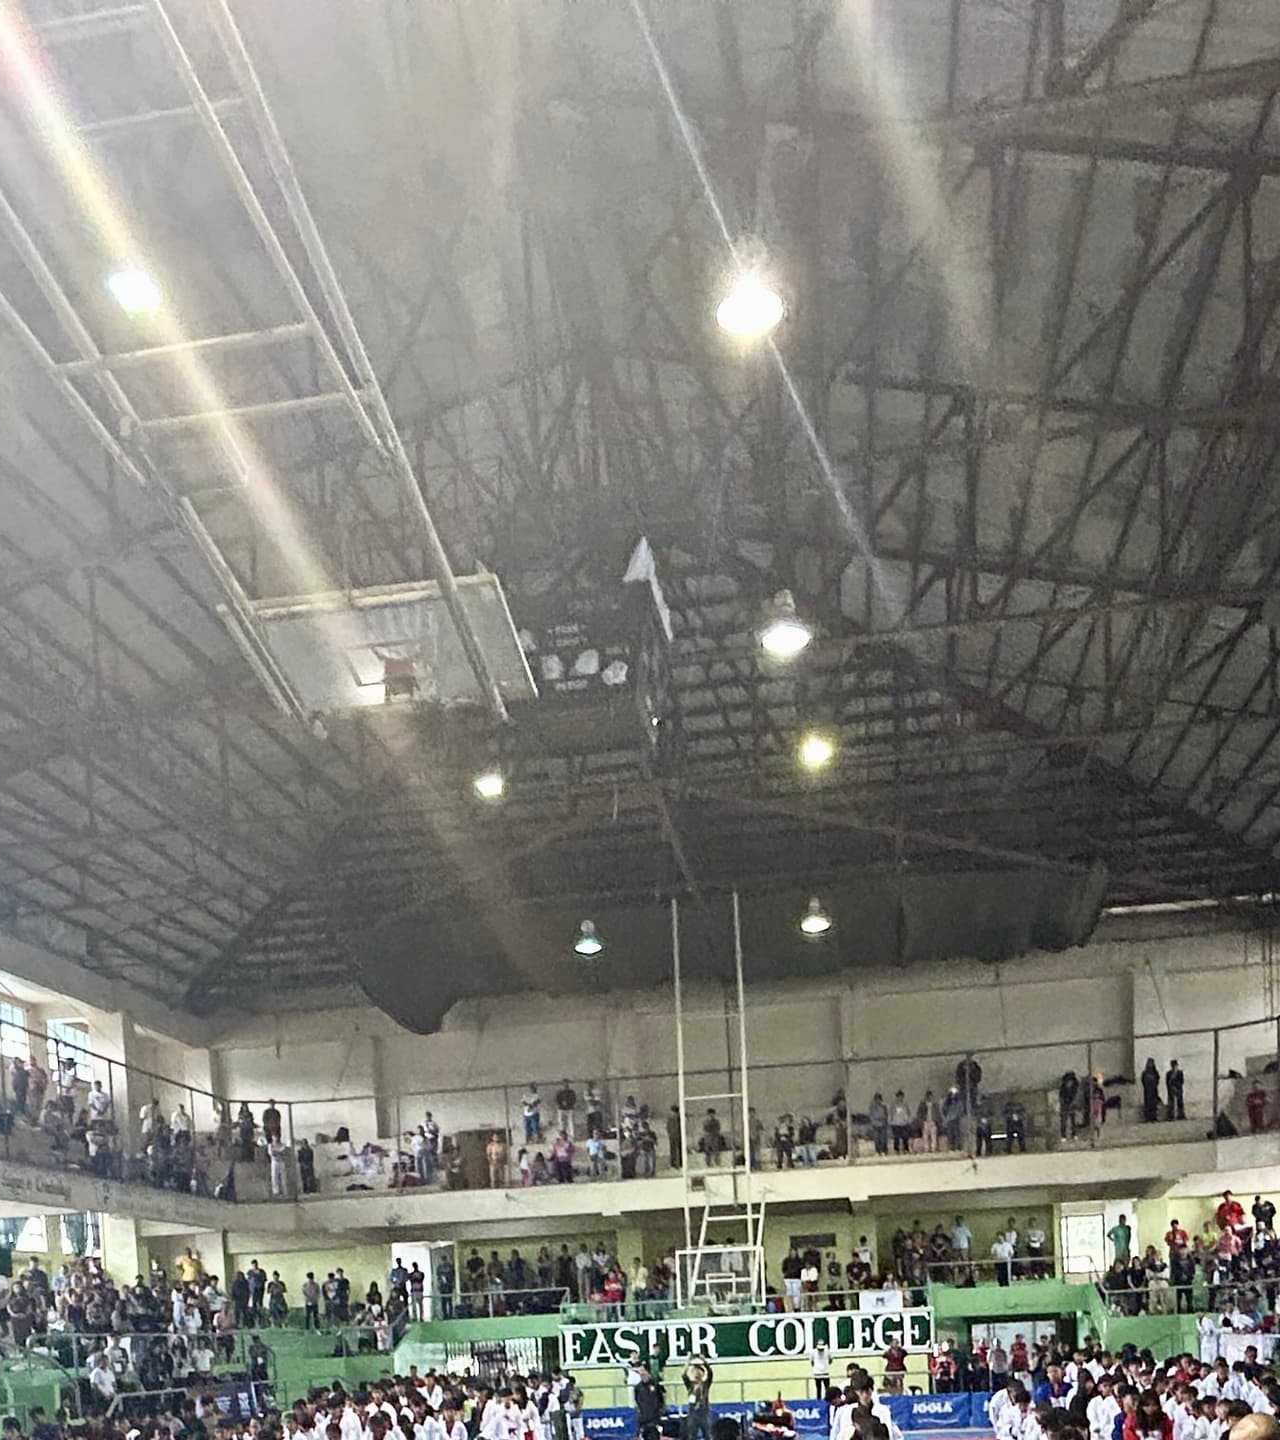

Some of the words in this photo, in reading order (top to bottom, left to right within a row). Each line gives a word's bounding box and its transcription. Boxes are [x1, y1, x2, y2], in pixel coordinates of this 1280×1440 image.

[563, 1322, 718, 1365] EASTER
[748, 1311, 931, 1357] COLLEGE
[912, 1401, 953, 1414] JOOLA
[585, 1416, 625, 1429] JOOLA
